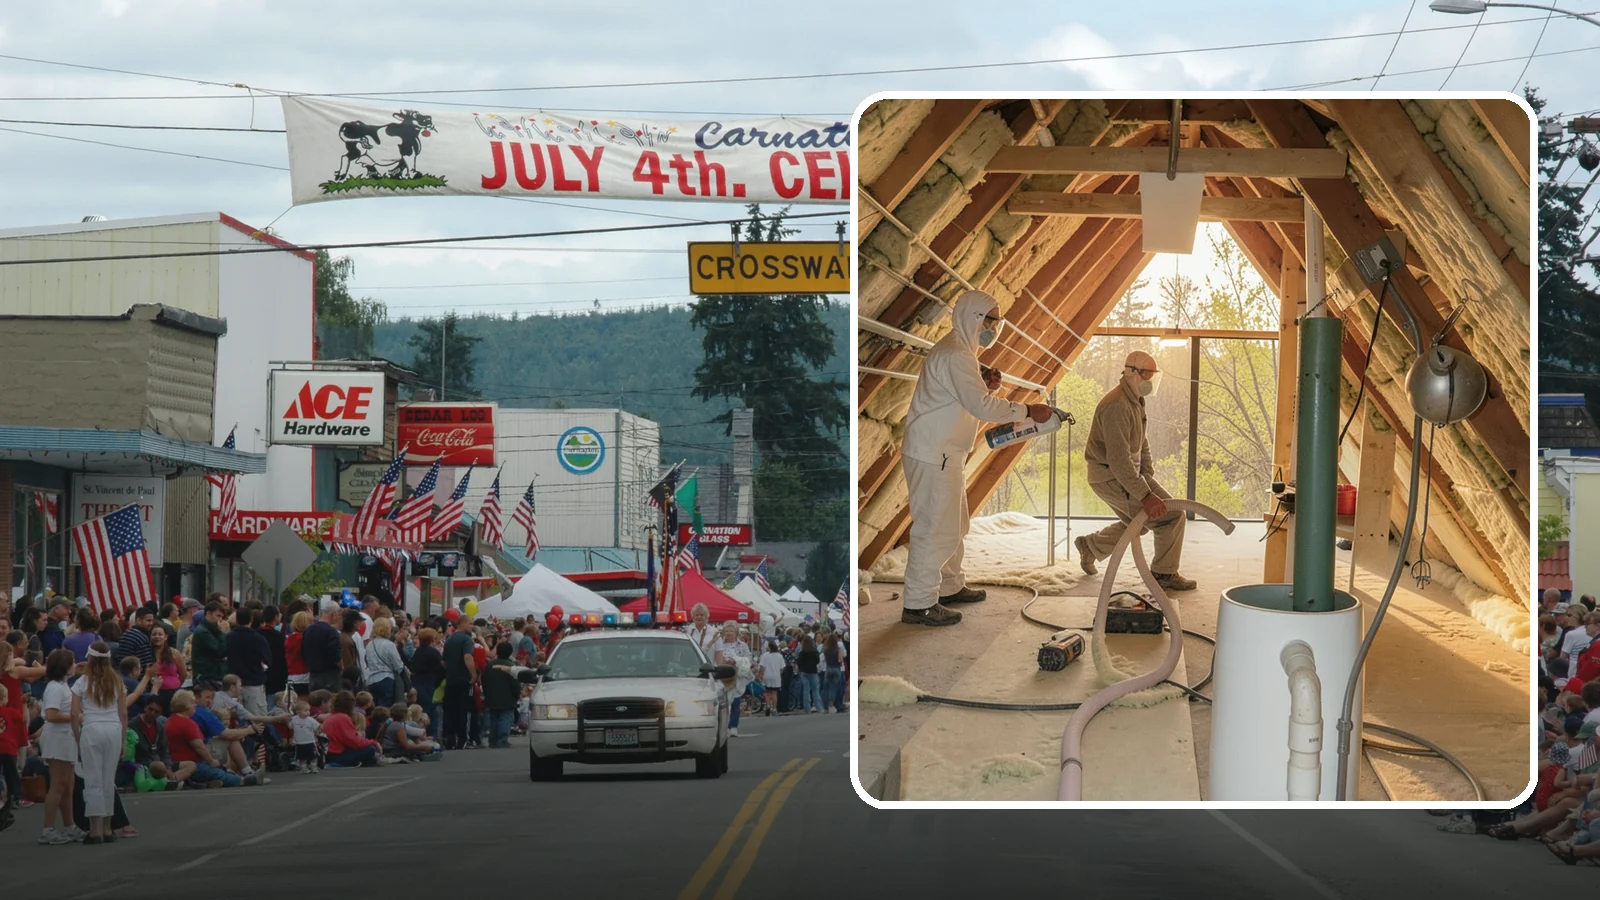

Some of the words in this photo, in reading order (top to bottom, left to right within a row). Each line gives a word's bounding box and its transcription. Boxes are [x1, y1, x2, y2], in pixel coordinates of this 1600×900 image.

[695, 121, 849, 149] Carnat
[481, 141, 605, 192] JULY
[632, 150, 746, 198] 4th.
[696, 254, 849, 280] CROSSWA
[283, 380, 373, 420] ACE
[405, 409, 452, 421] CEDAR
[461, 409, 485, 421] LOG
[283, 421, 371, 437] Hardware
[416, 428, 476, 447] Coca-Cola
[353, 467, 386, 480] Simpl
[83, 485, 93, 494] St.
[95, 485, 124, 495] Vincent
[126, 486, 136, 495] de
[137, 486, 155, 495] Paul
[688, 527, 741, 535] CRNATION
[699, 535, 730, 543] GLASS
